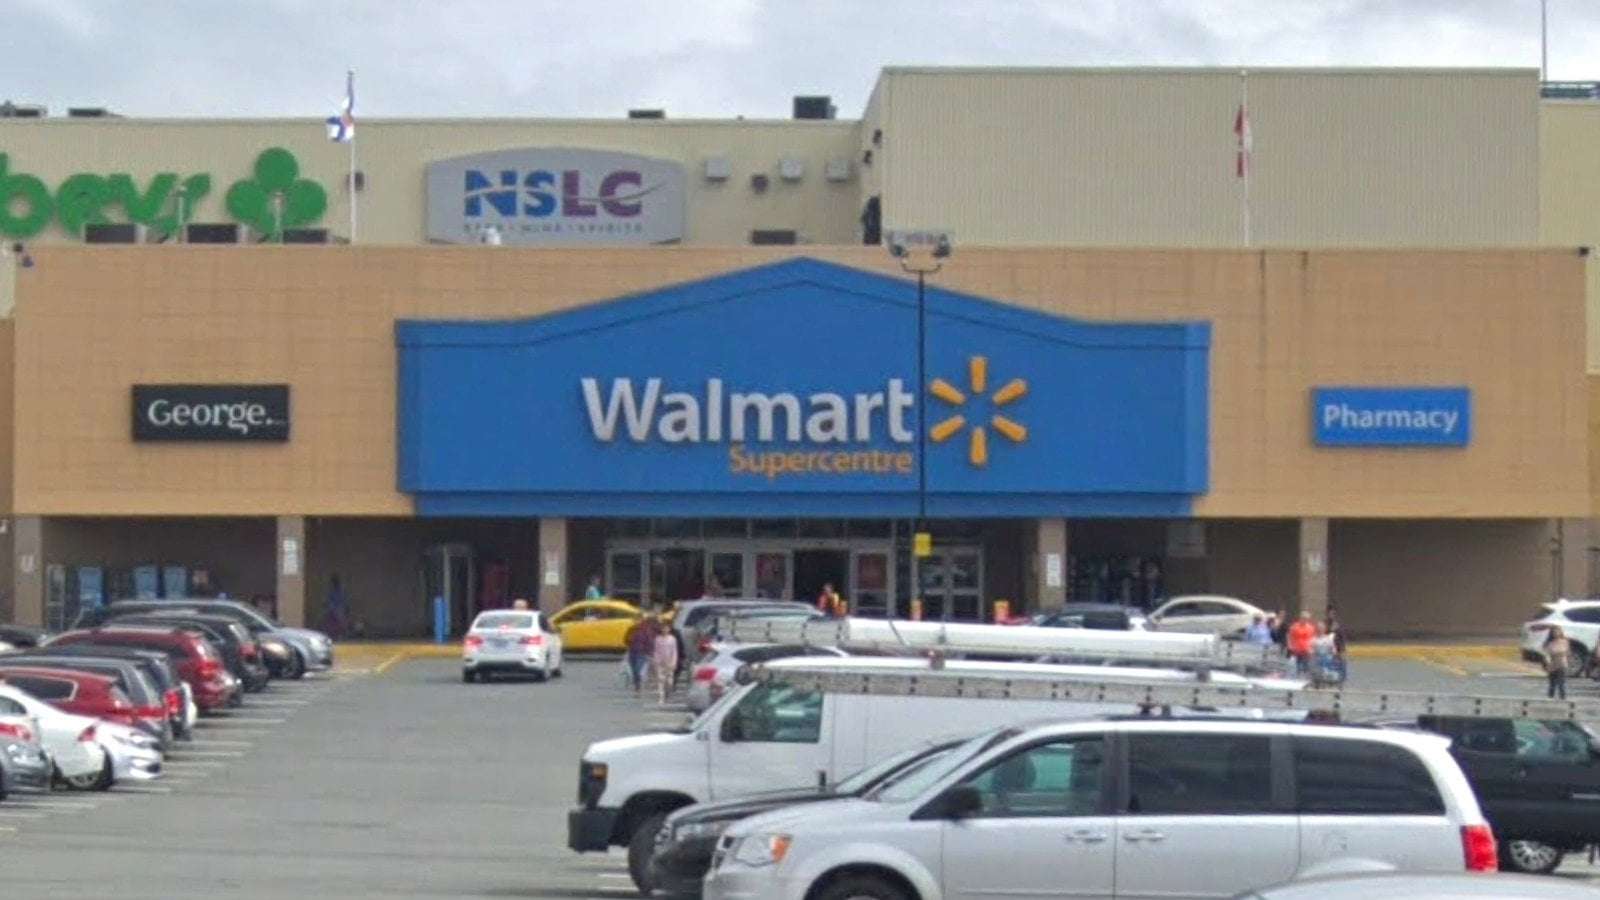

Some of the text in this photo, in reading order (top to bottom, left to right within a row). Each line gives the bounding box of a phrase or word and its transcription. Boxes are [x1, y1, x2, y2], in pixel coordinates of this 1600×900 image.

[464, 170, 642, 217] NSLC
[148, 398, 274, 434] George.
[580, 377, 914, 442] Walmart
[1323, 403, 1459, 434] Pharmacy
[729, 444, 913, 478] Supercentre
